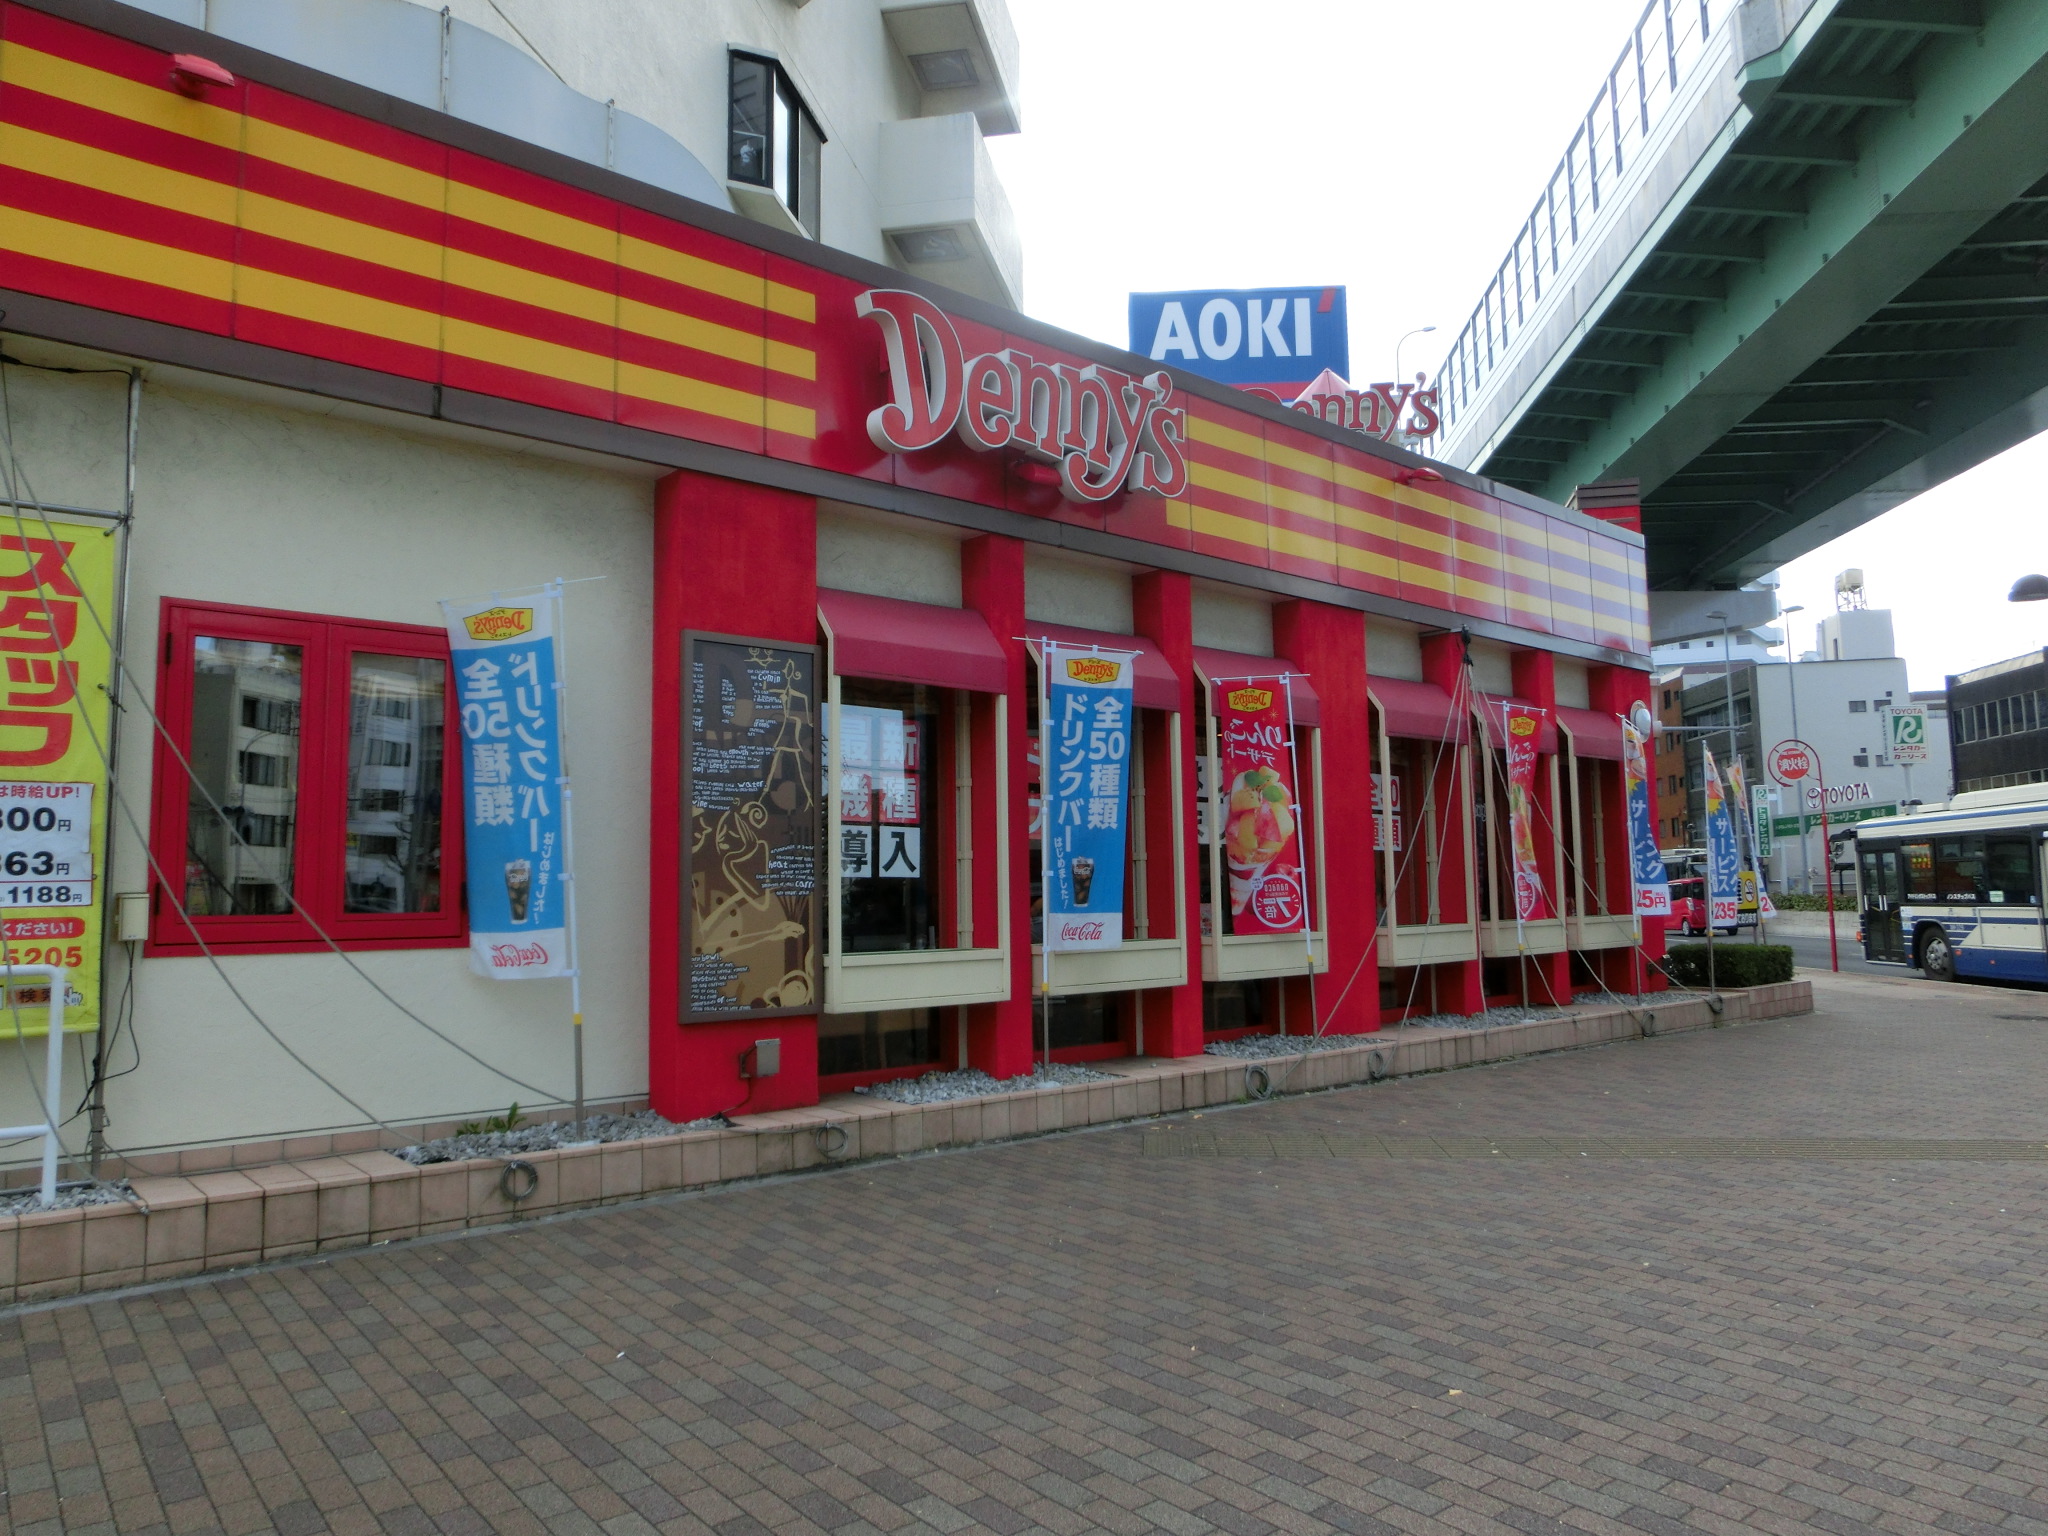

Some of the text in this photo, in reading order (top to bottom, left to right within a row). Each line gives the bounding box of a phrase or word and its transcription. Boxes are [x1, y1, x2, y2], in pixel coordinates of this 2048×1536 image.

[1149, 297, 1313, 361] AOKI
[854, 287, 1188, 502] Denny's
[1073, 661, 1114, 679] Denny's
[1058, 693, 1089, 852] ドリンクバー
[1088, 696, 1125, 829] 全50種類
[1778, 756, 1809, 771] 消火栓
[1822, 782, 1871, 805] TOYOTA
[0, 806, 72, 832] 00円
[0, 850, 70, 876] 63円
[1715, 817, 1730, 892] サービス
[7, 886, 83, 904] 1188円
